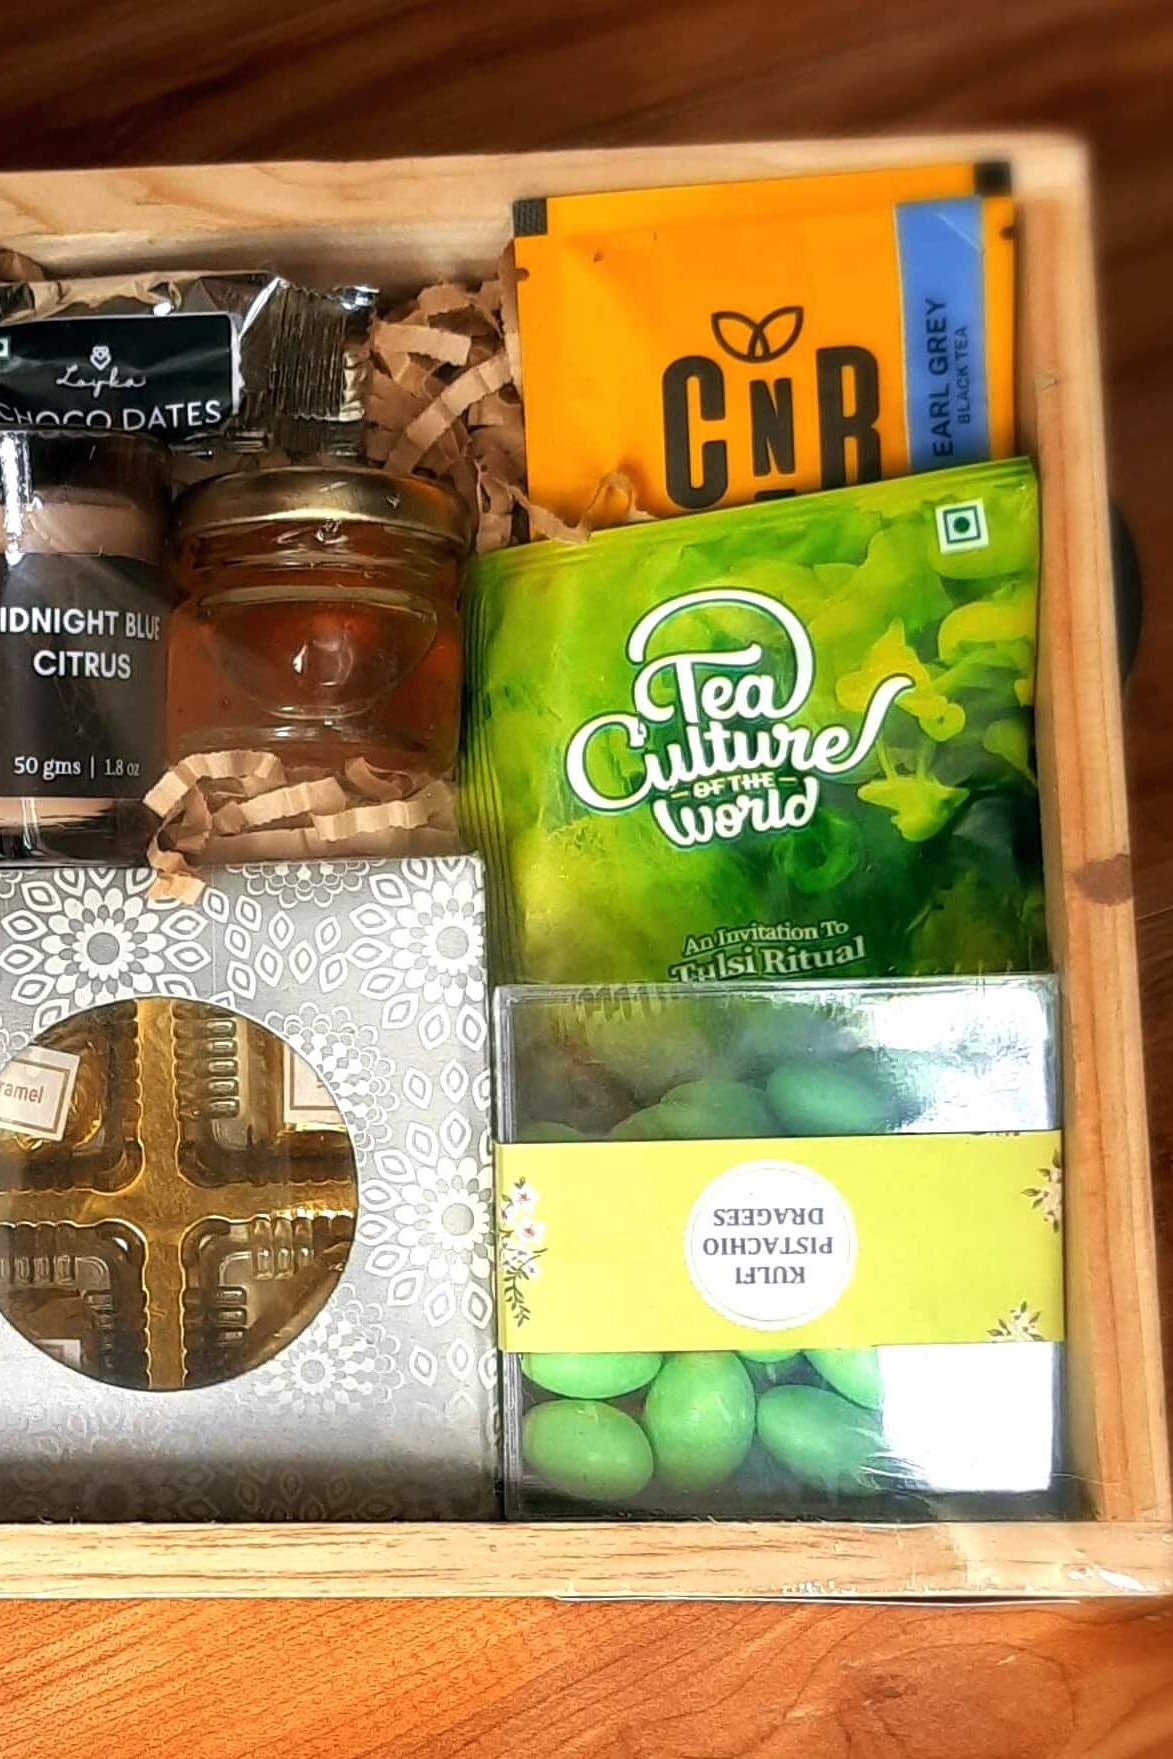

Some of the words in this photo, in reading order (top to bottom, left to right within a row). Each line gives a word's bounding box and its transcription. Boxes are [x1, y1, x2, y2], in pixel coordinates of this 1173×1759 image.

[926, 297, 947, 376] GREY
[954, 325, 969, 361] TEA
[955, 366, 971, 425] BLACK
[122, 400, 222, 431] DATES
[929, 382, 954, 458] EARL
[125, 611, 160, 641] BLUE
[32, 649, 131, 679] CITRUS
[627, 588, 812, 724] Tea
[565, 675, 914, 812] Culture
[14, 756, 38, 774] 50
[43, 760, 82, 780] gms
[104, 758, 124, 777] 1.8
[126, 763, 140, 776] oz
[693, 778, 724, 799] OF
[730, 771, 775, 791] THE
[683, 934, 715, 956] An
[717, 922, 819, 946] Invitation
[820, 919, 850, 940] To
[671, 945, 758, 982] Tulsi
[761, 935, 867, 975] Ritual
[713, 1207, 824, 1227] DRAGEES
[702, 1237, 834, 1256] PISTACHIO
[735, 1266, 807, 1285] KULFI
